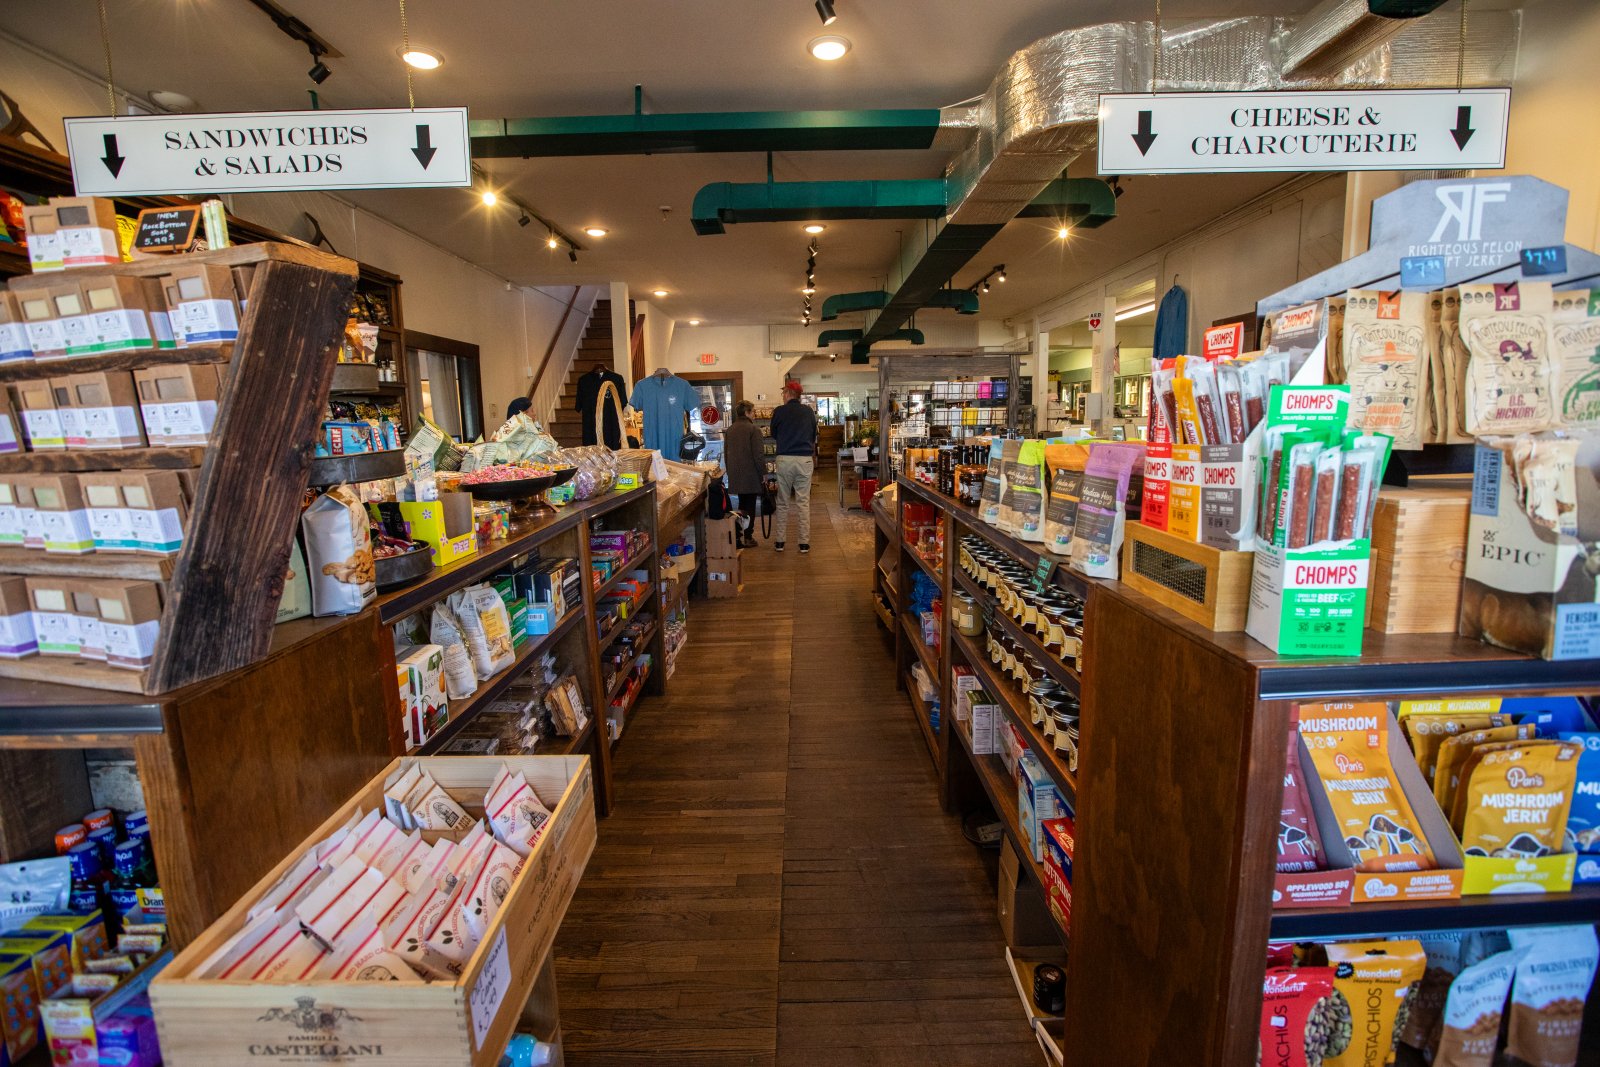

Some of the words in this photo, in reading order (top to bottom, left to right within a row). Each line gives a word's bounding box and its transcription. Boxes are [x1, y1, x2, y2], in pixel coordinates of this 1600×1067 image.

[1230, 106, 1350, 127] CHEESE
[1358, 106, 1381, 126] &
[164, 126, 368, 150] SANDWICHES
[1191, 133, 1417, 156] CHARCUTERIE
[195, 157, 217, 176] &
[225, 153, 343, 175] SALADS
[1408, 243, 1478, 257] RIGHTEOUS
[1482, 240, 1522, 254] FELON
[1465, 254, 1504, 267] JERKY
[1211, 331, 1234, 347] CHOMPS
[702, 354, 715, 364] EXIT
[1286, 394, 1334, 410] CHOMPS
[1496, 407, 1536, 420] HICKORY
[332, 428, 342, 448] CLIF
[1171, 464, 1195, 482] CHOMPS
[1204, 467, 1236, 485] CHOMPS
[1481, 543, 1542, 567] EPIC
[1295, 565, 1358, 585] CHOMPS
[1317, 593, 1339, 603] BEEF
[1298, 716, 1377, 732] MUSHROOM
[1335, 753, 1364, 773] Pan's
[1325, 776, 1392, 792] MUSHROOM
[1507, 767, 1543, 788] Pan's
[1351, 791, 1389, 805] JERKY
[1481, 792, 1564, 808] MUSHROOM
[1503, 808, 1550, 823] JERKY
[115, 851, 133, 861] NyQuil
[1384, 860, 1420, 872] ORIGINAL
[1286, 881, 1334, 892] APPLEWOOD
[1335, 880, 1350, 889] BBQ
[1410, 874, 1452, 886] ORIGINAL
[1568, 957, 1594, 972] DINER
[1356, 968, 1402, 979] Wonderful
[248, 1044, 383, 1056] CASTELLANI
